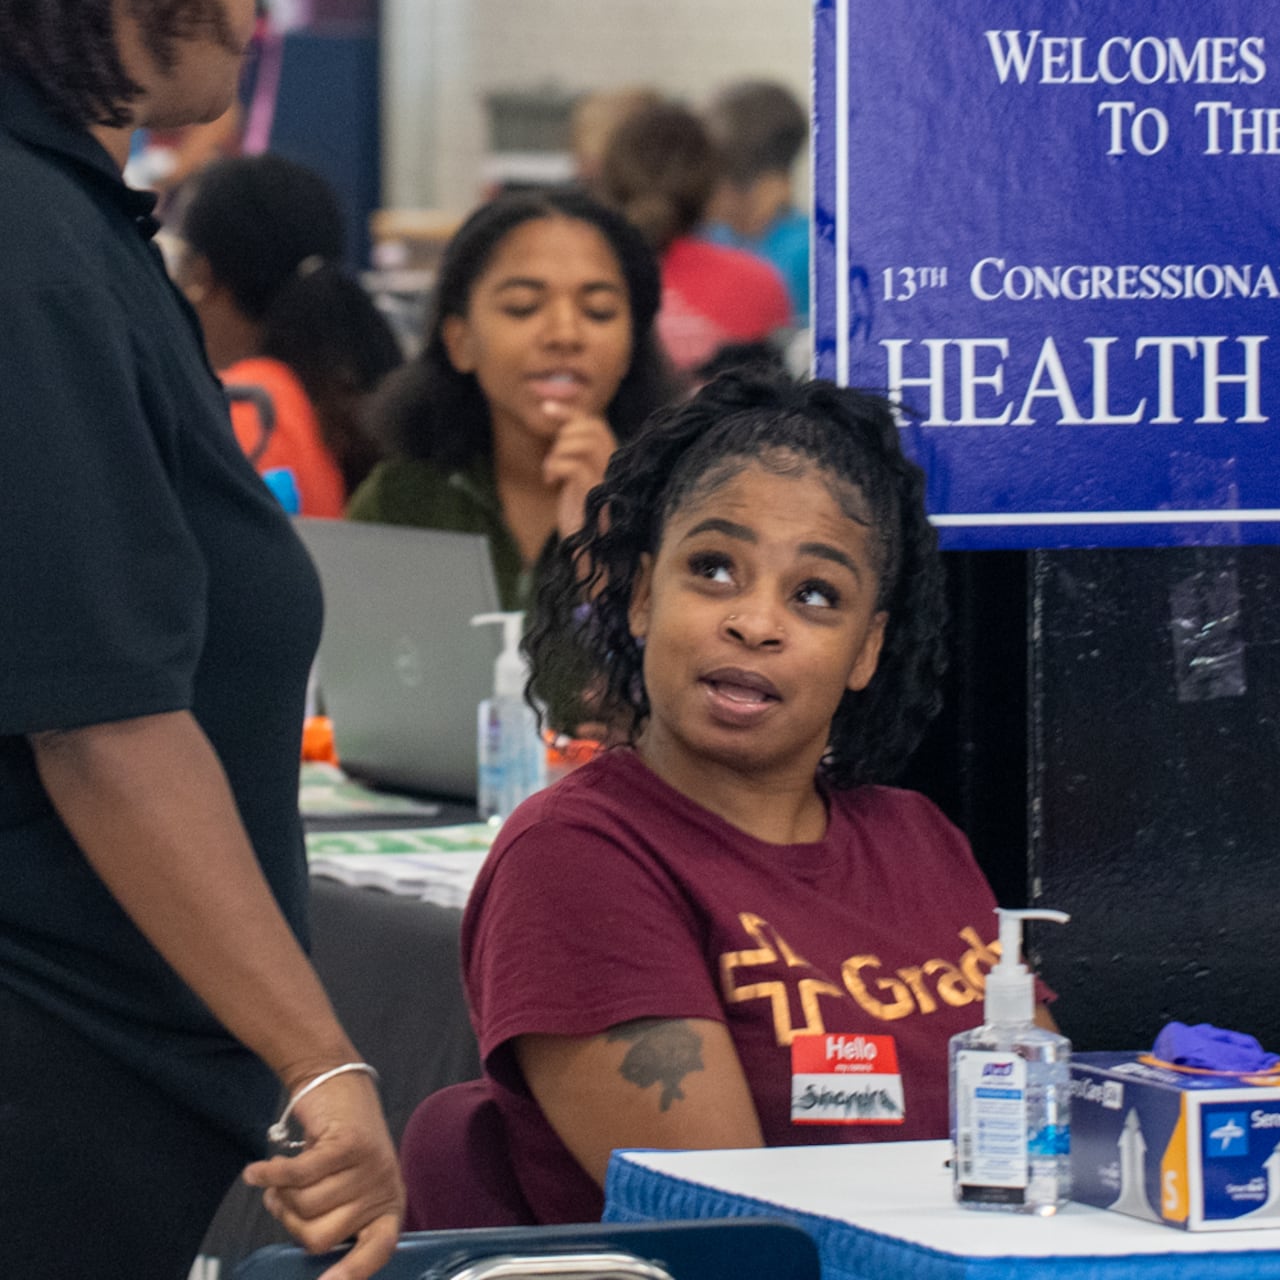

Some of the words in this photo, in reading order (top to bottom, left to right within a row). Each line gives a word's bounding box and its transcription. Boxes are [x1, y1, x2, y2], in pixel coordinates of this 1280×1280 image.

[985, 30, 1267, 86] WELCOMES
[1097, 102, 1169, 156] TO
[882, 265, 949, 303] 13TH
[880, 334, 1270, 428] HEALTH
[840, 926, 1003, 1021] Grad
[825, 1036, 878, 1061] Hello
[1163, 1170, 1180, 1211] S
